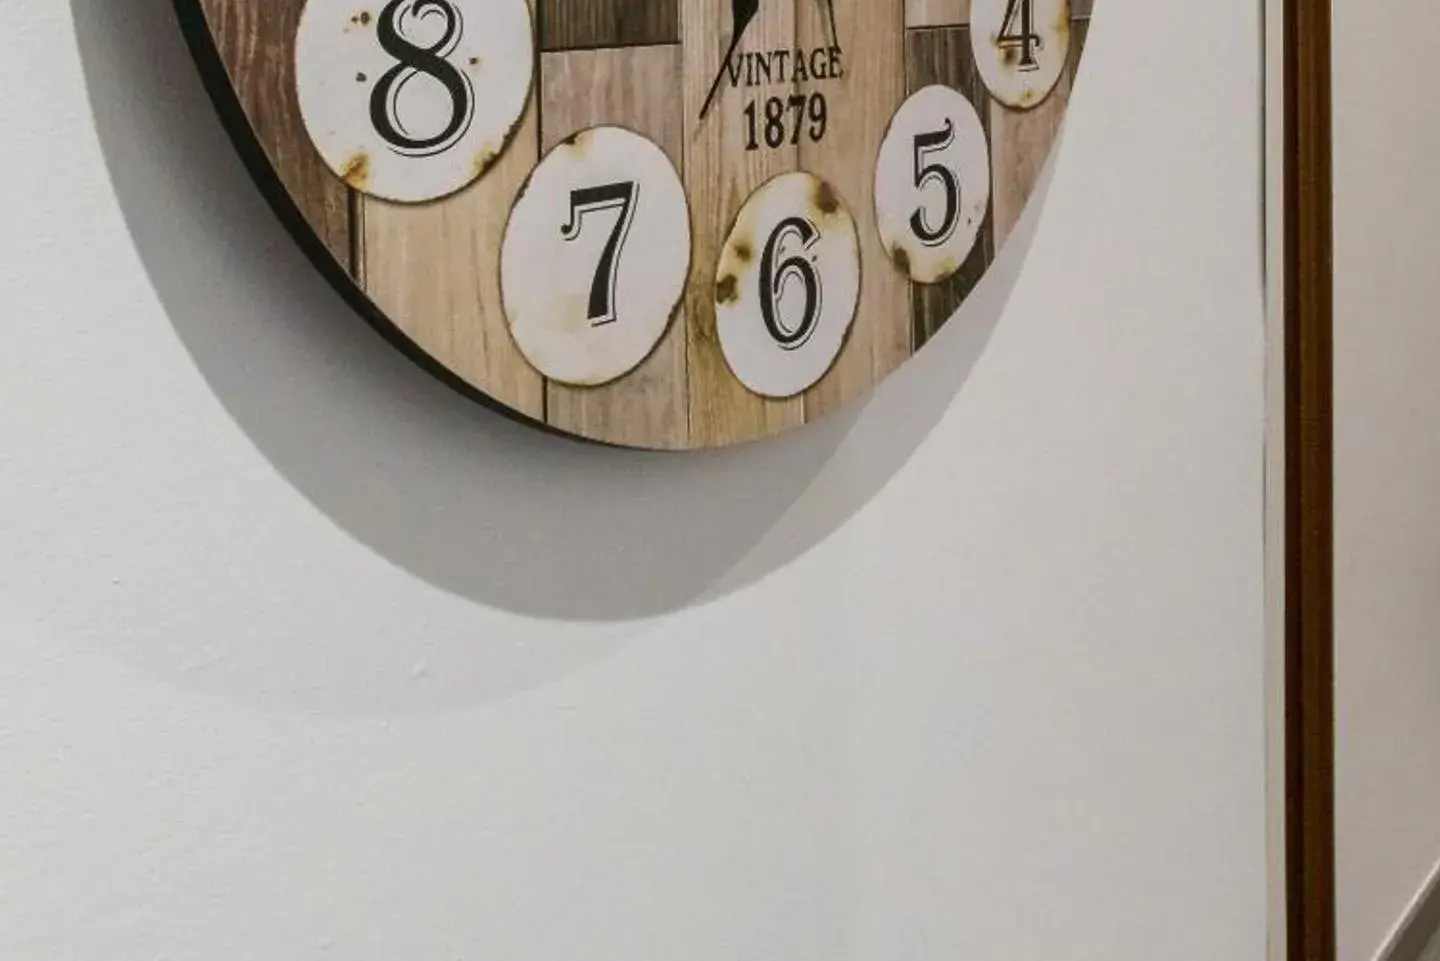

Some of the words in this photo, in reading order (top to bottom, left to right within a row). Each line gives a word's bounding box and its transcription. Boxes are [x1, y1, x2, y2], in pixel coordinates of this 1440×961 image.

[727, 46, 844, 88] VINTAGE
[743, 92, 828, 151] 1879
[910, 118, 961, 247] 5
[561, 180, 638, 328] 7
[759, 217, 822, 351] 6
